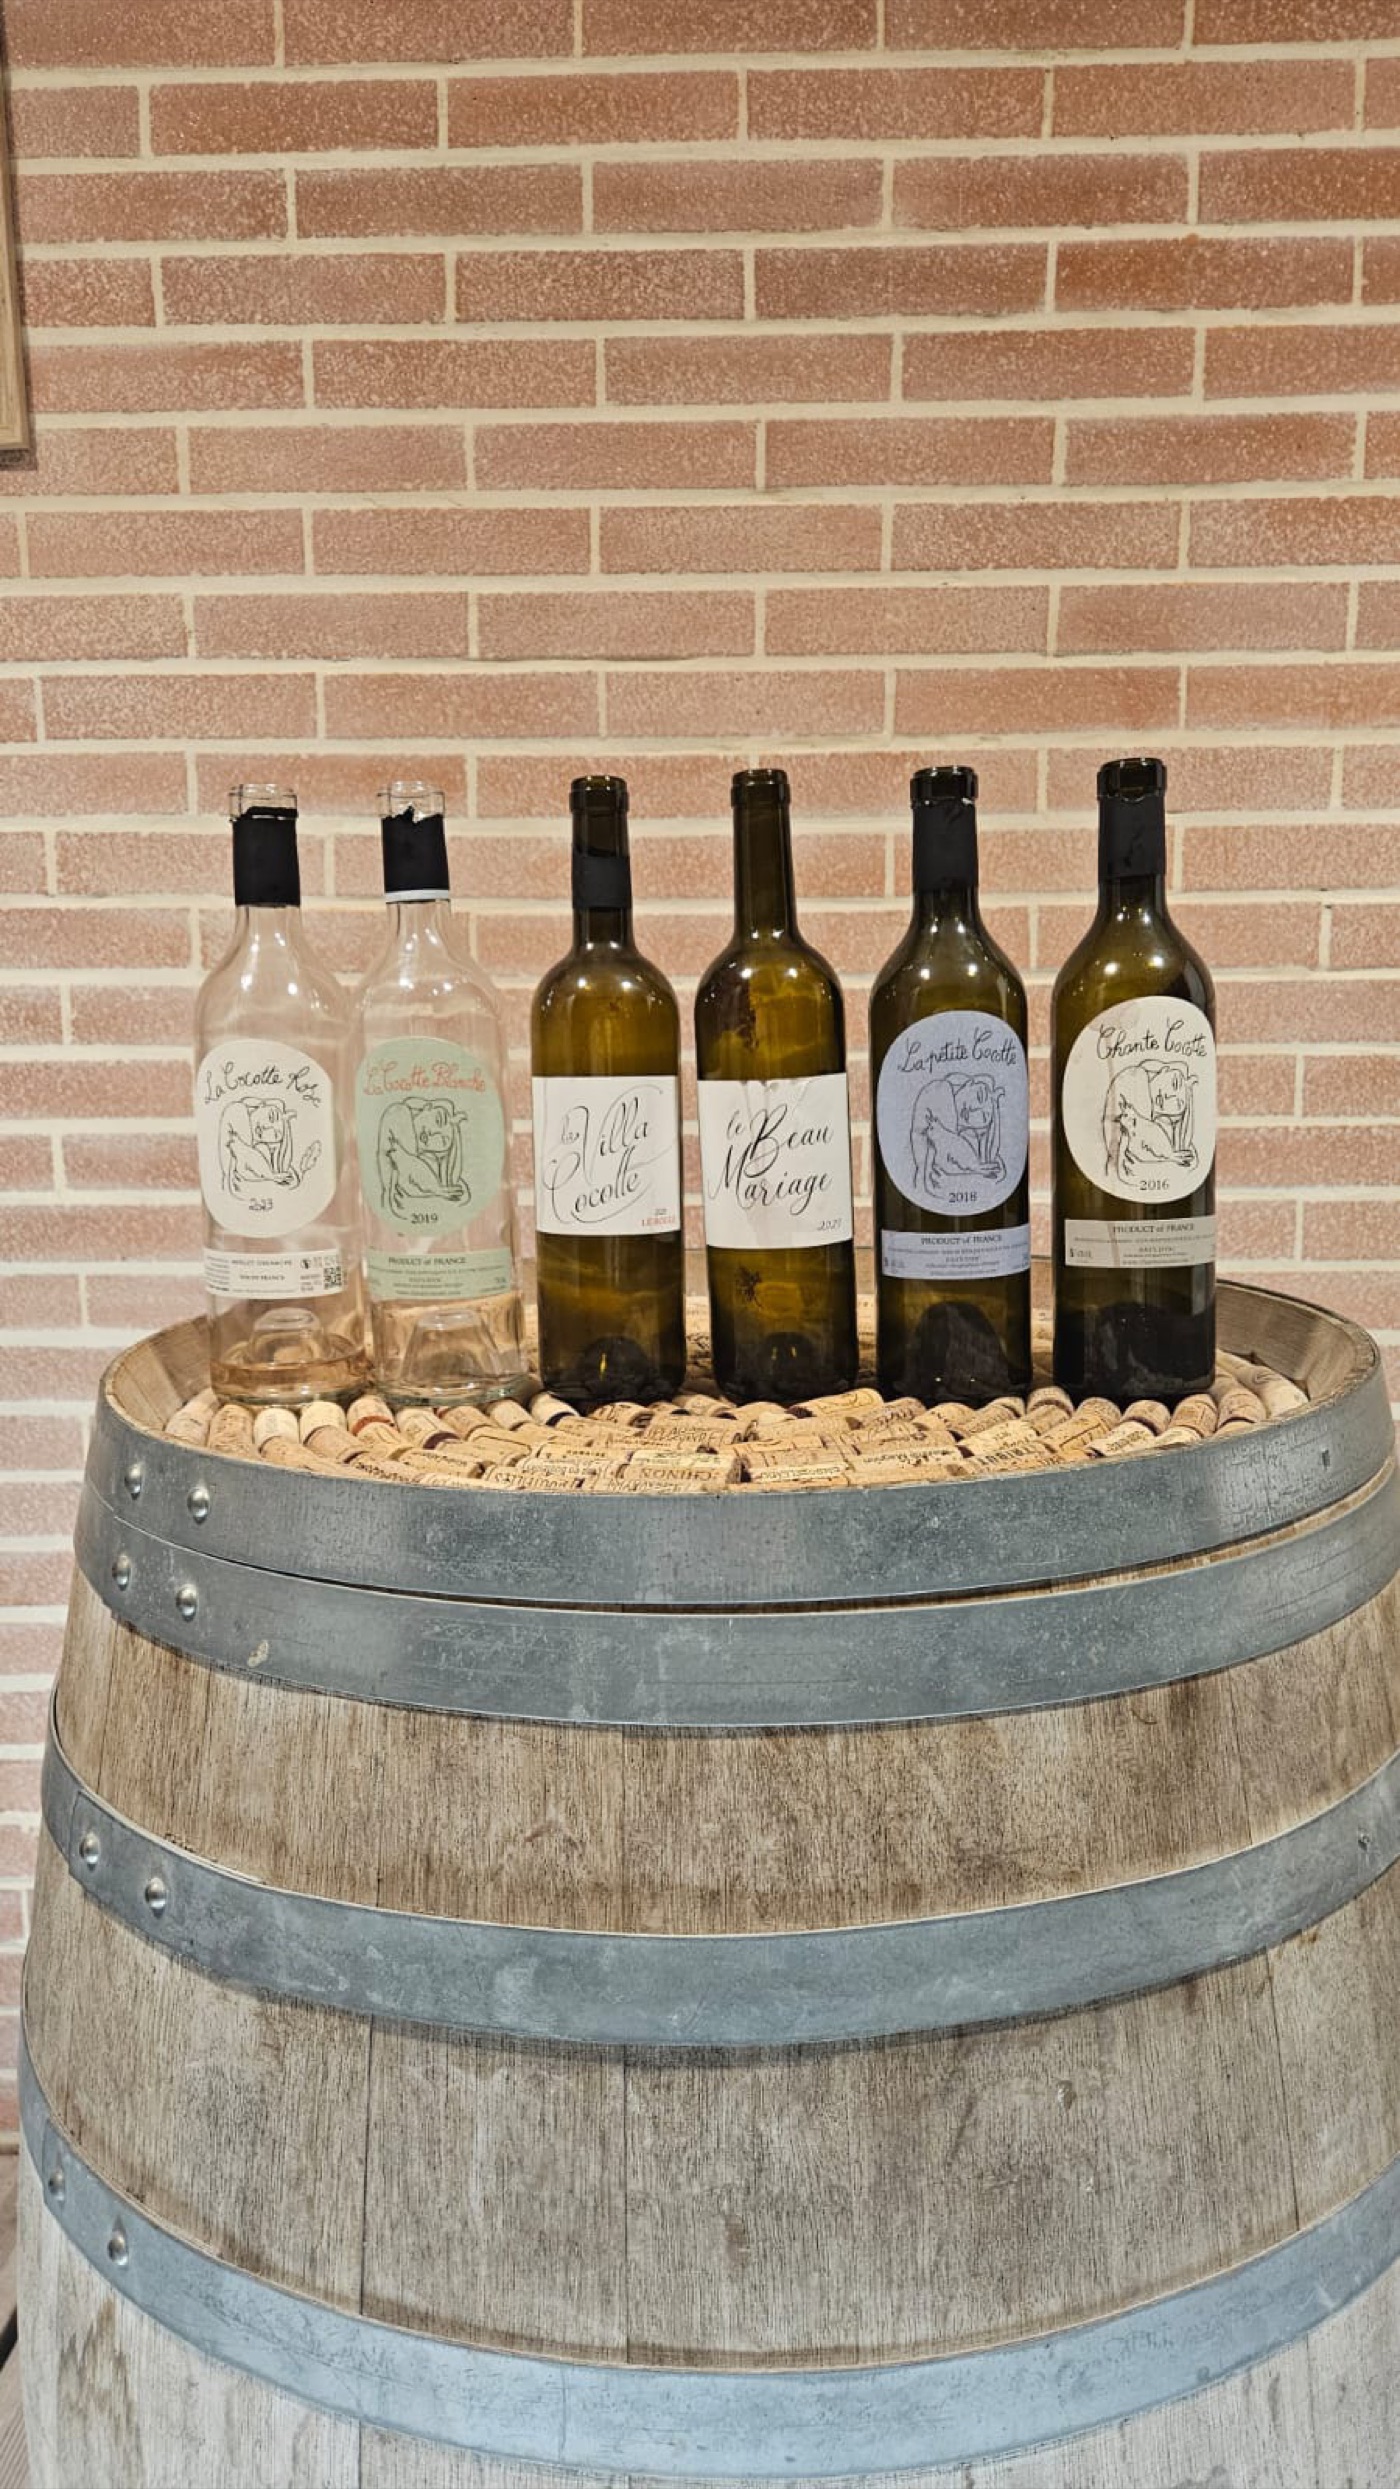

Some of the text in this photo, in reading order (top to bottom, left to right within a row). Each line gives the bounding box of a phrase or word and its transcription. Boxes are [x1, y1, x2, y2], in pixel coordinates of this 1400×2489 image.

[898, 1026, 1017, 1073] La petite Cocotte
[1097, 1016, 1207, 1060] Chante Cocotte
[205, 1069, 226, 1105] La
[222, 1061, 283, 1091] Cocotte
[364, 1066, 384, 1096] La
[380, 1060, 430, 1092] Cocotte
[743, 1103, 835, 1179] Beau
[708, 1143, 832, 1216] Mariage
[1139, 1180, 1171, 1191] 2016
[410, 1213, 439, 1225] 2019
[1112, 1225, 1155, 1233] PRODUCT
[1166, 1223, 1195, 1232] FRANCE
[920, 1236, 961, 1246] PRODUCT
[972, 1234, 1003, 1244] FRANCE
[388, 1256, 422, 1266] PRODUCT
[433, 1256, 468, 1266] FRANCE
